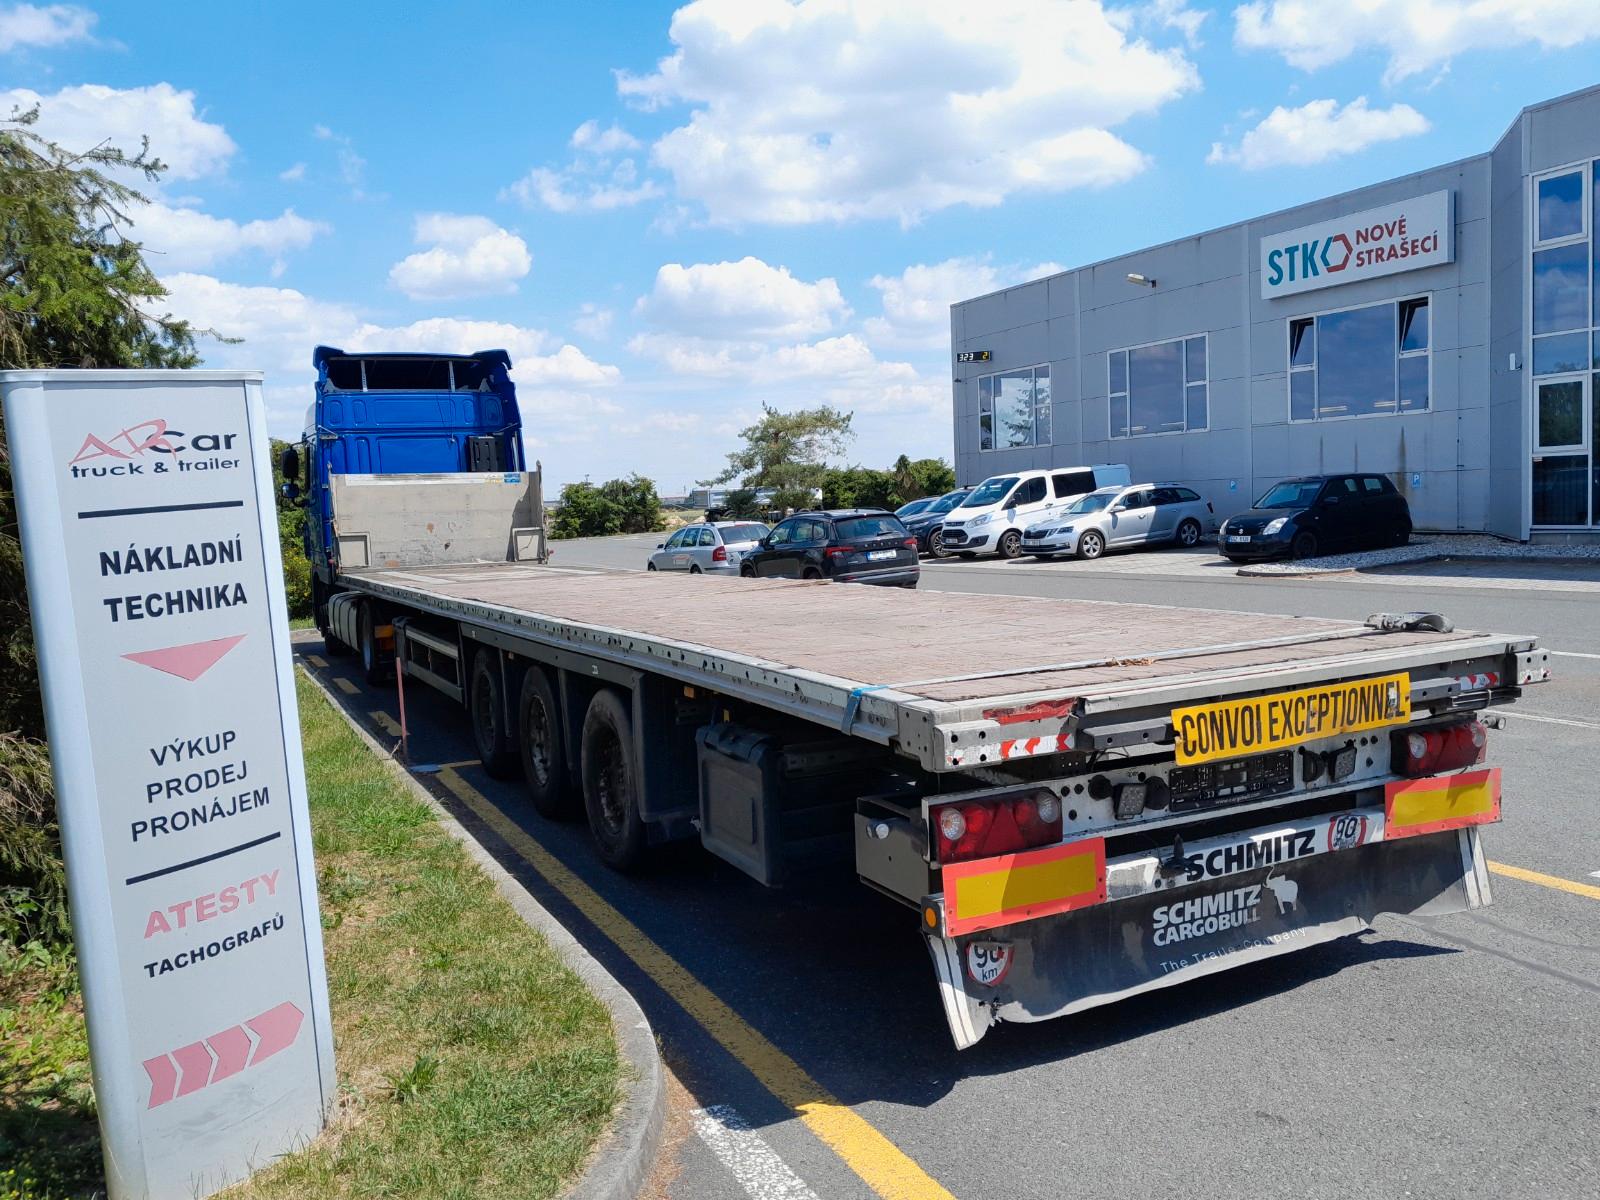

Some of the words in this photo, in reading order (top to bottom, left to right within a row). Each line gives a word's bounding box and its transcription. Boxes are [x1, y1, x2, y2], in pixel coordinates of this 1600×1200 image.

[1355, 214, 1407, 245] NOVÉ
[1355, 230, 1438, 268] STRAŠECÍ
[1268, 239, 1320, 287] STK
[70, 462, 145, 478] truck
[153, 461, 169, 474] &
[178, 457, 240, 472] trailer
[99, 533, 243, 577] NÁKLADNÍ
[103, 582, 248, 622] TECHNIKA
[1180, 703, 1262, 758] CONVOI
[1268, 680, 1406, 743] EXCEPTIONNEL
[150, 730, 236, 767] VÝKUP
[146, 760, 248, 803] PRODEJ
[131, 786, 270, 842] PRONÁJEM
[1186, 829, 1316, 881] SCHMITZ
[143, 869, 280, 939] ATESTY
[1153, 884, 1263, 929] SCHMITZ
[143, 912, 285, 978] TACHOGRAFŮ
[1153, 907, 1261, 947] CARGOBULL
[1160, 957, 1188, 974] The
[1243, 927, 1307, 951] Company
[982, 967, 998, 981] km
